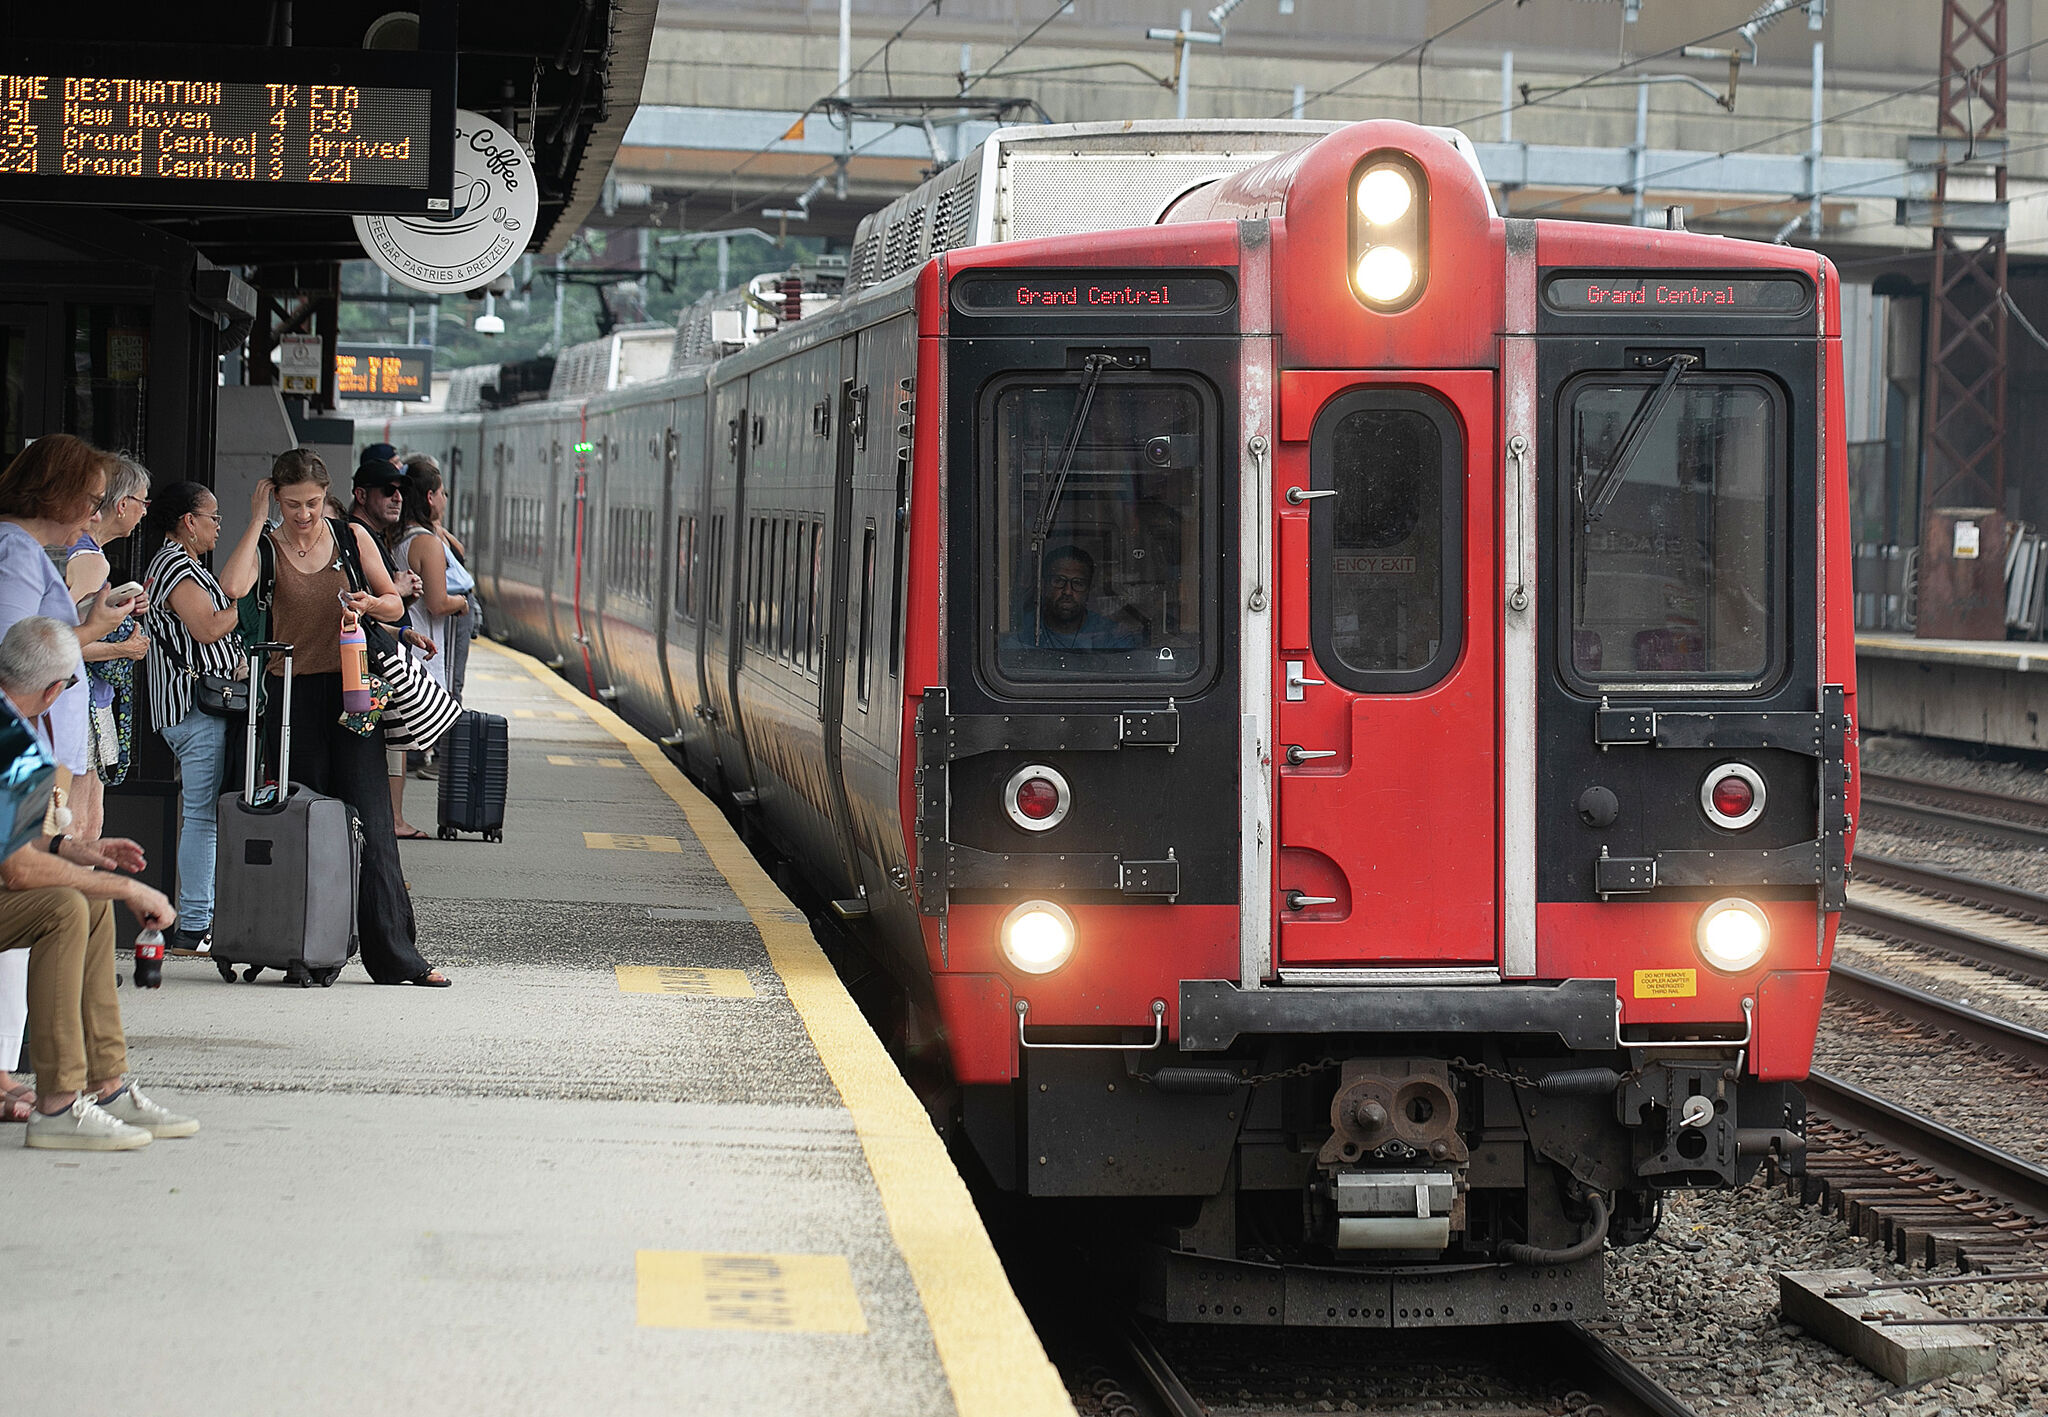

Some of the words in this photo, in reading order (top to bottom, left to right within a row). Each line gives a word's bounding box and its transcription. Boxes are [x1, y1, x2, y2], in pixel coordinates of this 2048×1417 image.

[0, 75, 48, 99] TIME
[64, 78, 221, 106] DESTINATION
[266, 84, 297, 106] TK
[311, 86, 358, 108] ETA
[0, 100, 29, 123] :51
[64, 102, 112, 125] New
[129, 104, 210, 128] Haven
[271, 109, 287, 130] 4
[310, 110, 352, 133] 1:59
[0, 125, 38, 148] :55
[63, 127, 142, 151] Grand
[159, 130, 256, 154] Central
[270, 133, 284, 155] 3
[309, 134, 409, 161] Arrived
[63, 151, 142, 175] Grand
[158, 154, 256, 179] Central
[269, 158, 283, 179] 3
[309, 159, 350, 181] 2:21
[403, 260, 454, 280] PASTRIES
[457, 271, 464, 279] &
[466, 235, 511, 277] PRETZELS
[1017, 287, 1077, 304] Grand
[1089, 287, 1168, 304] Central
[1588, 287, 1645, 303] Grand
[1657, 287, 1733, 304] Central
[1334, 559, 1377, 571] ENCY
[1381, 559, 1413, 571] EXIT
